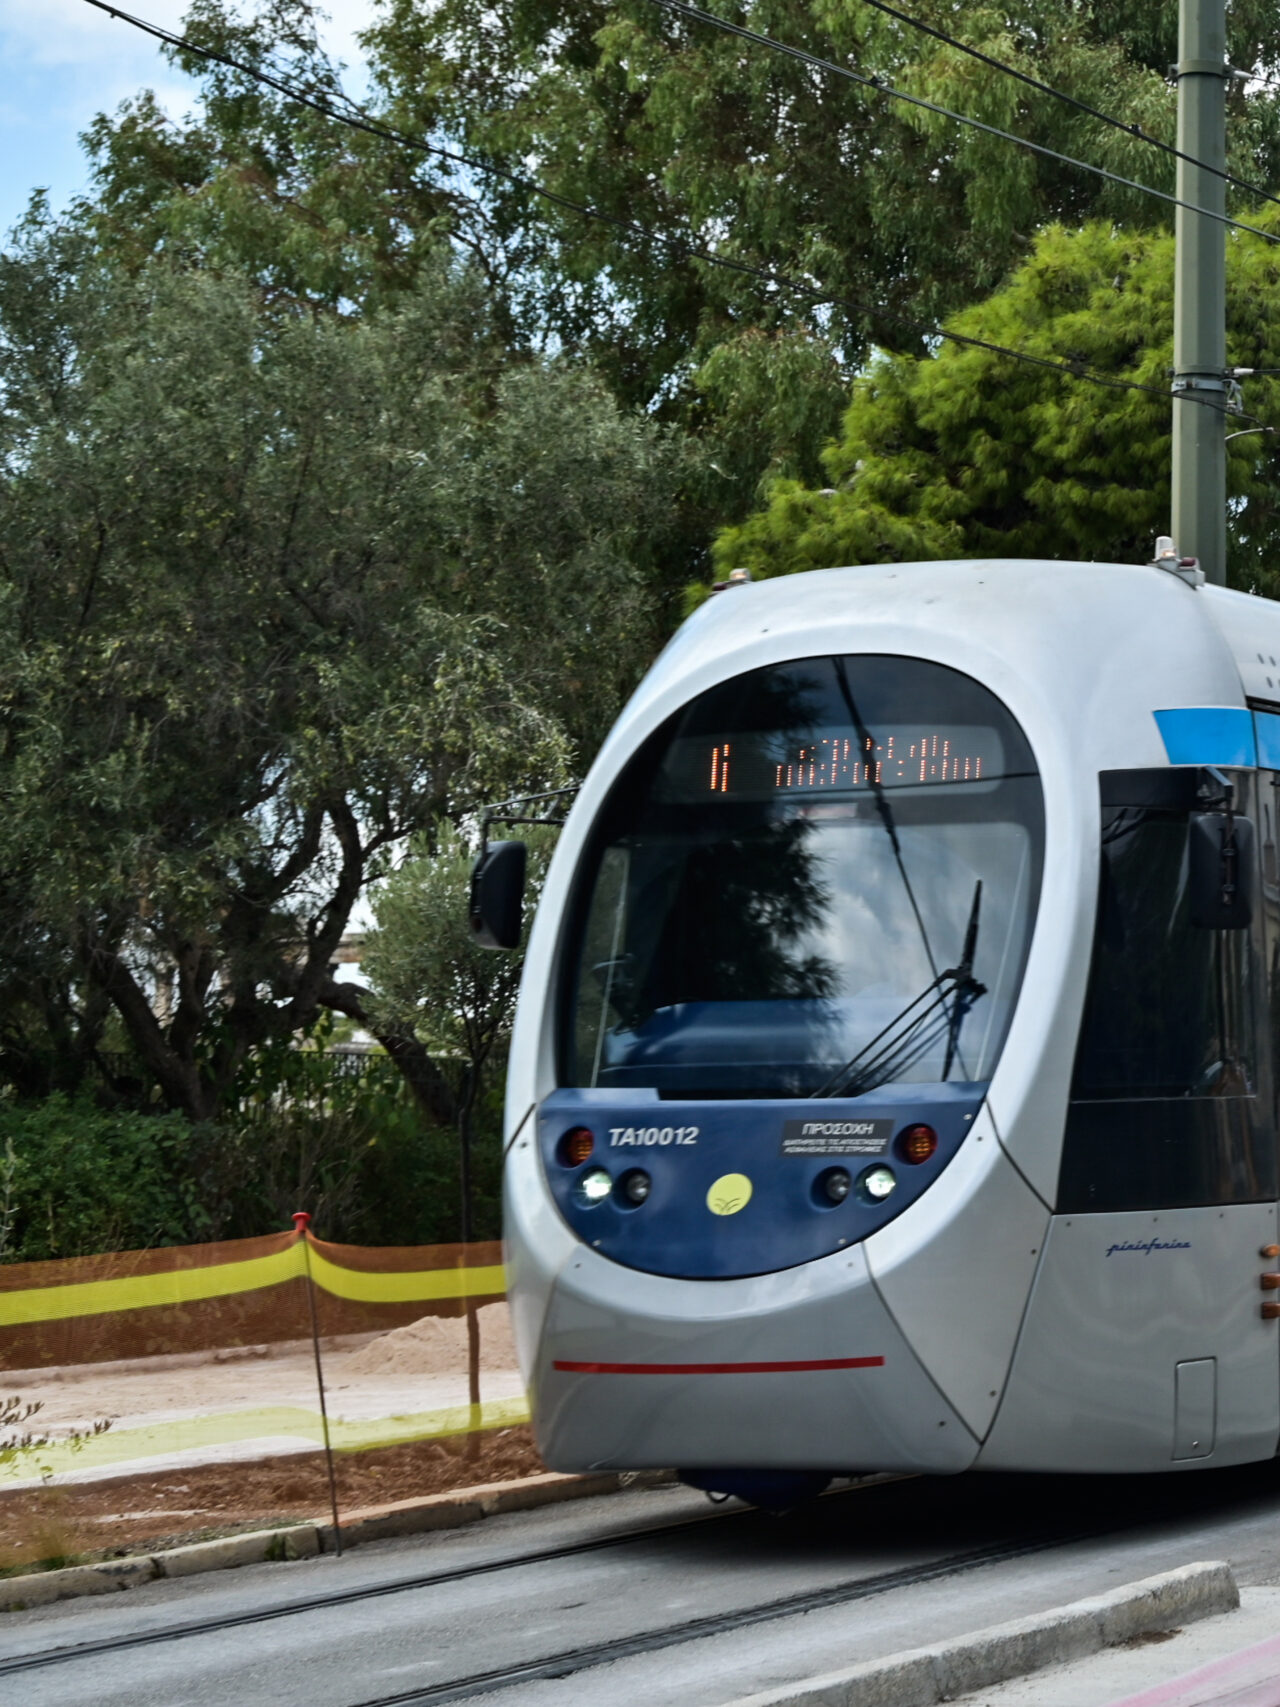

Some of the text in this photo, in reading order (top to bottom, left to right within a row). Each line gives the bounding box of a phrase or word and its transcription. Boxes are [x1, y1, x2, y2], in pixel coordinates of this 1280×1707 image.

[608, 1126, 700, 1146] TA10012
[801, 1122, 875, 1136] ΠΡΟΣΟΧΗ
[1105, 1237, 1192, 1258] pininfarina
